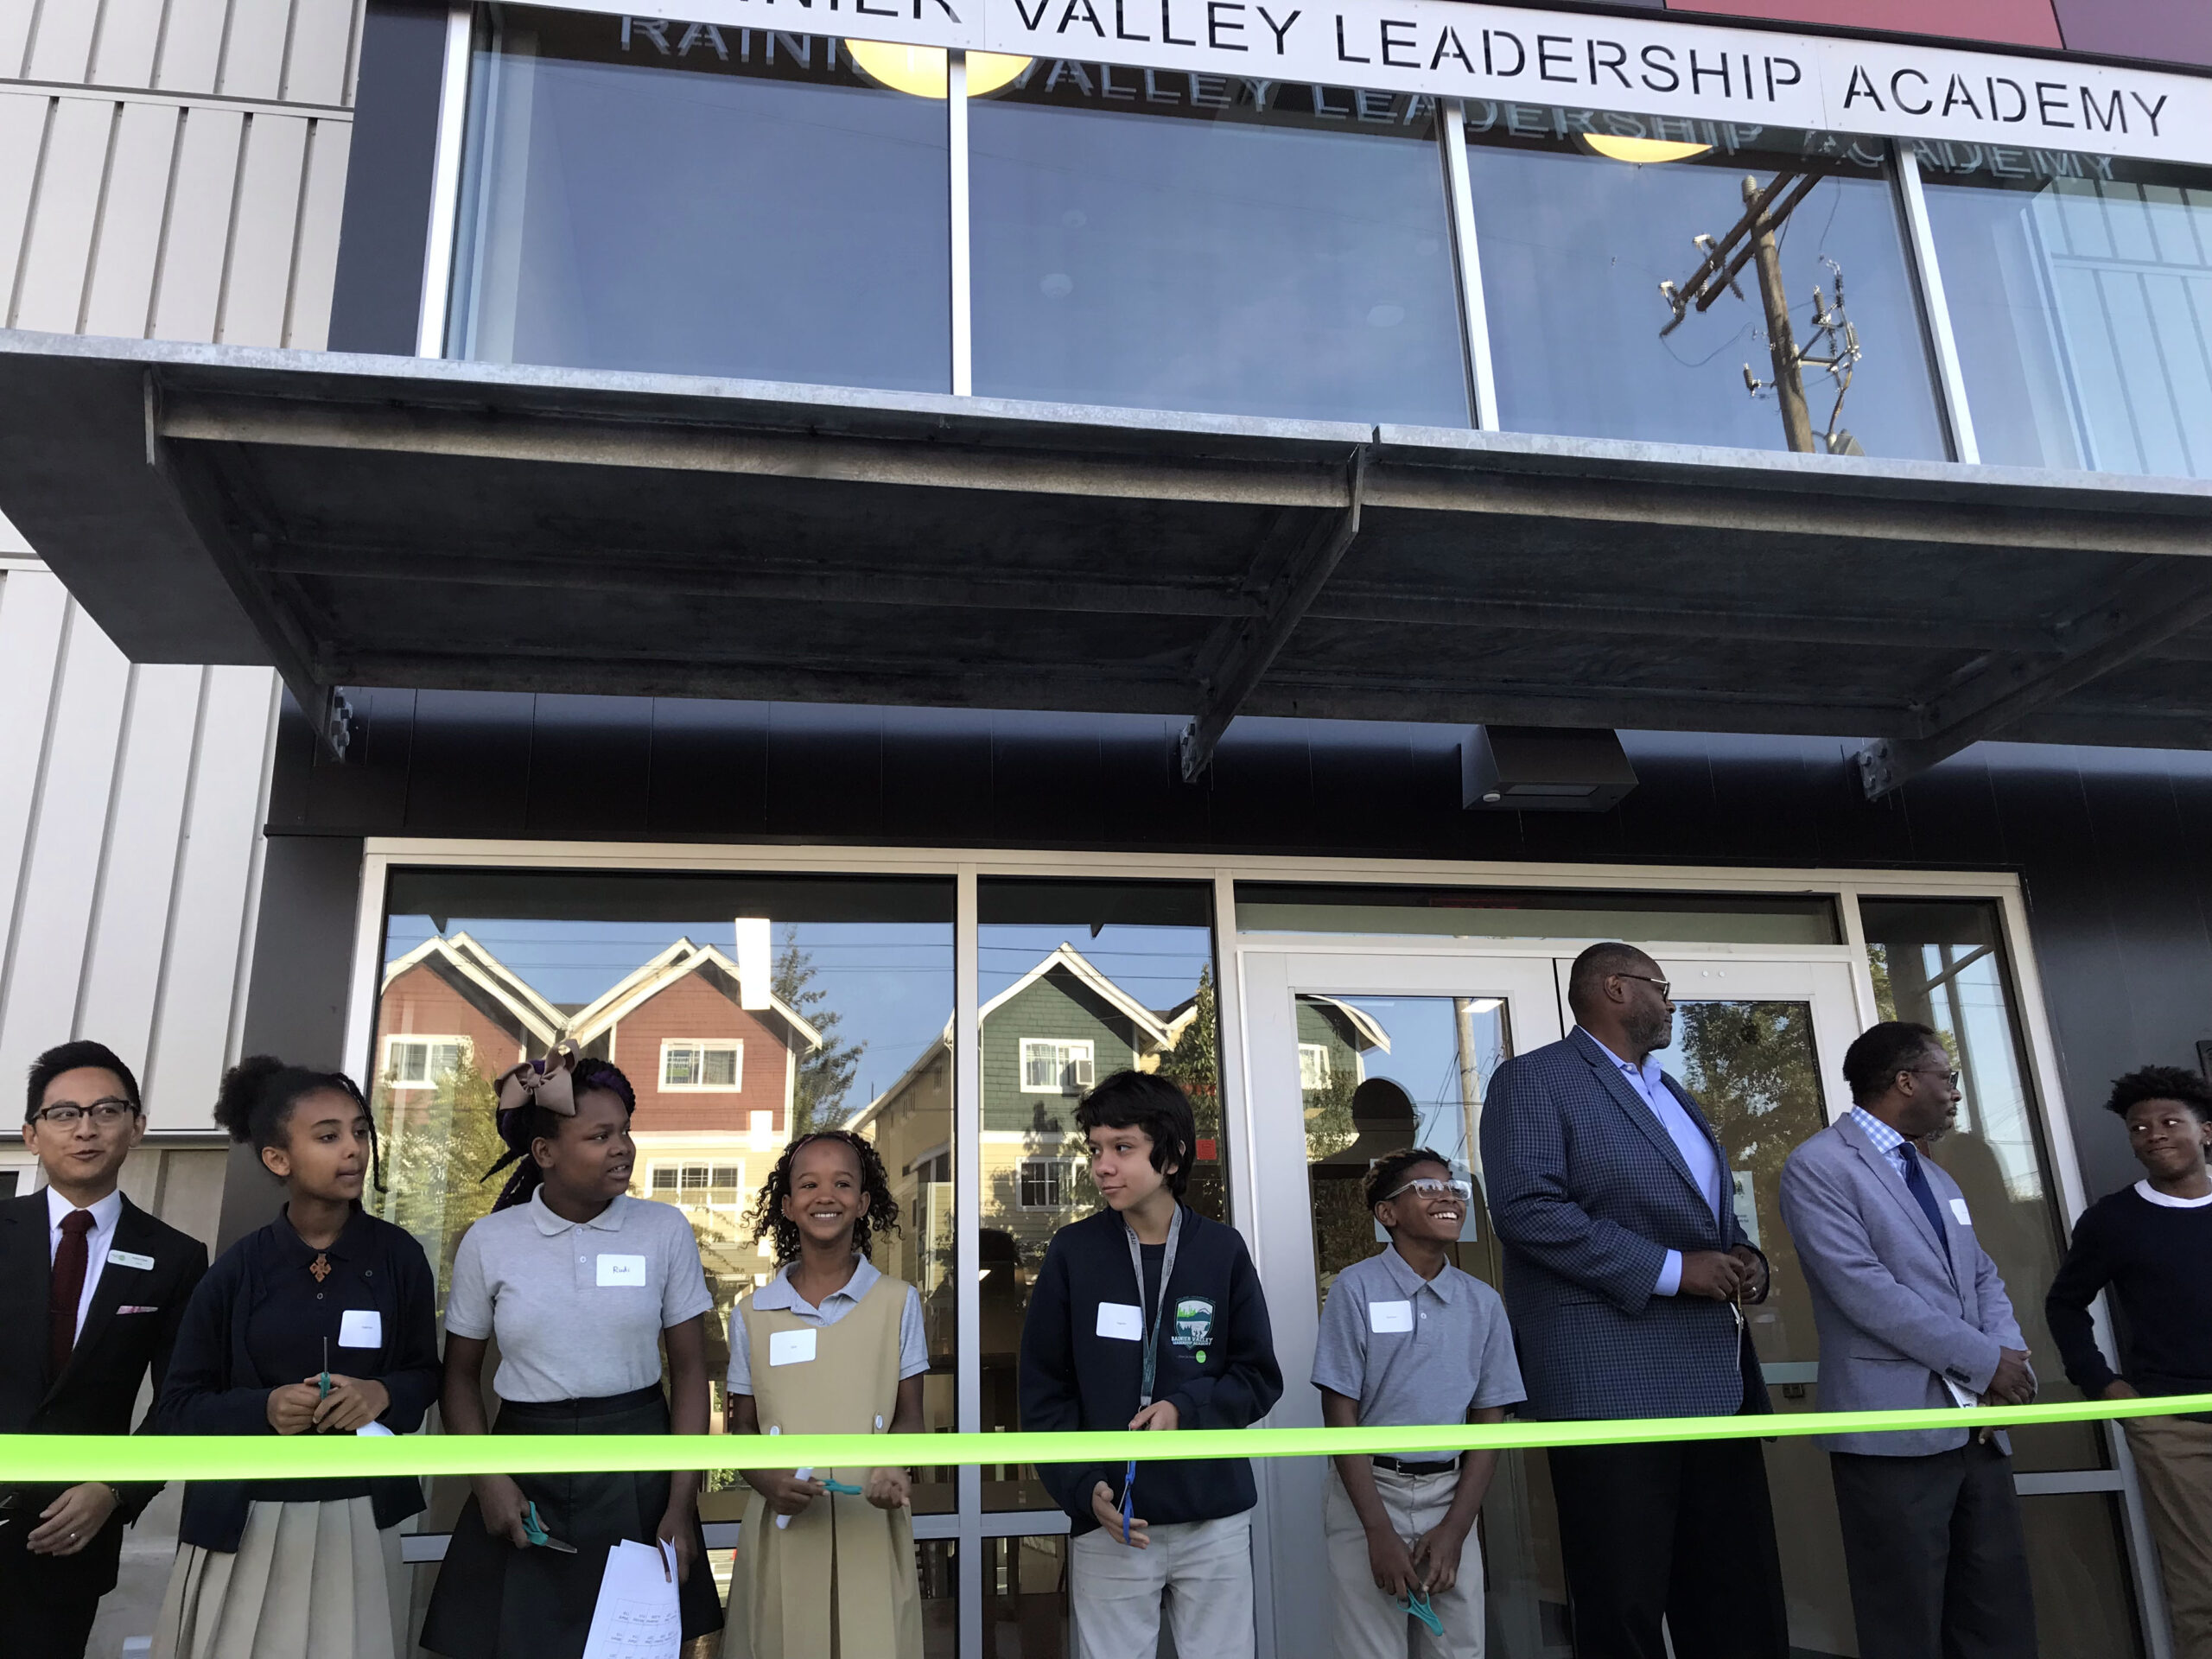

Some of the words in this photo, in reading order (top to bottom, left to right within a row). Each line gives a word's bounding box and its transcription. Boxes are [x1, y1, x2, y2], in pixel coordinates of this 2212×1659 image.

[1014, 0, 1303, 55] VALLEY
[1335, 14, 1802, 102] LEADERSHIP
[1843, 64, 2169, 137] ACADEMY
